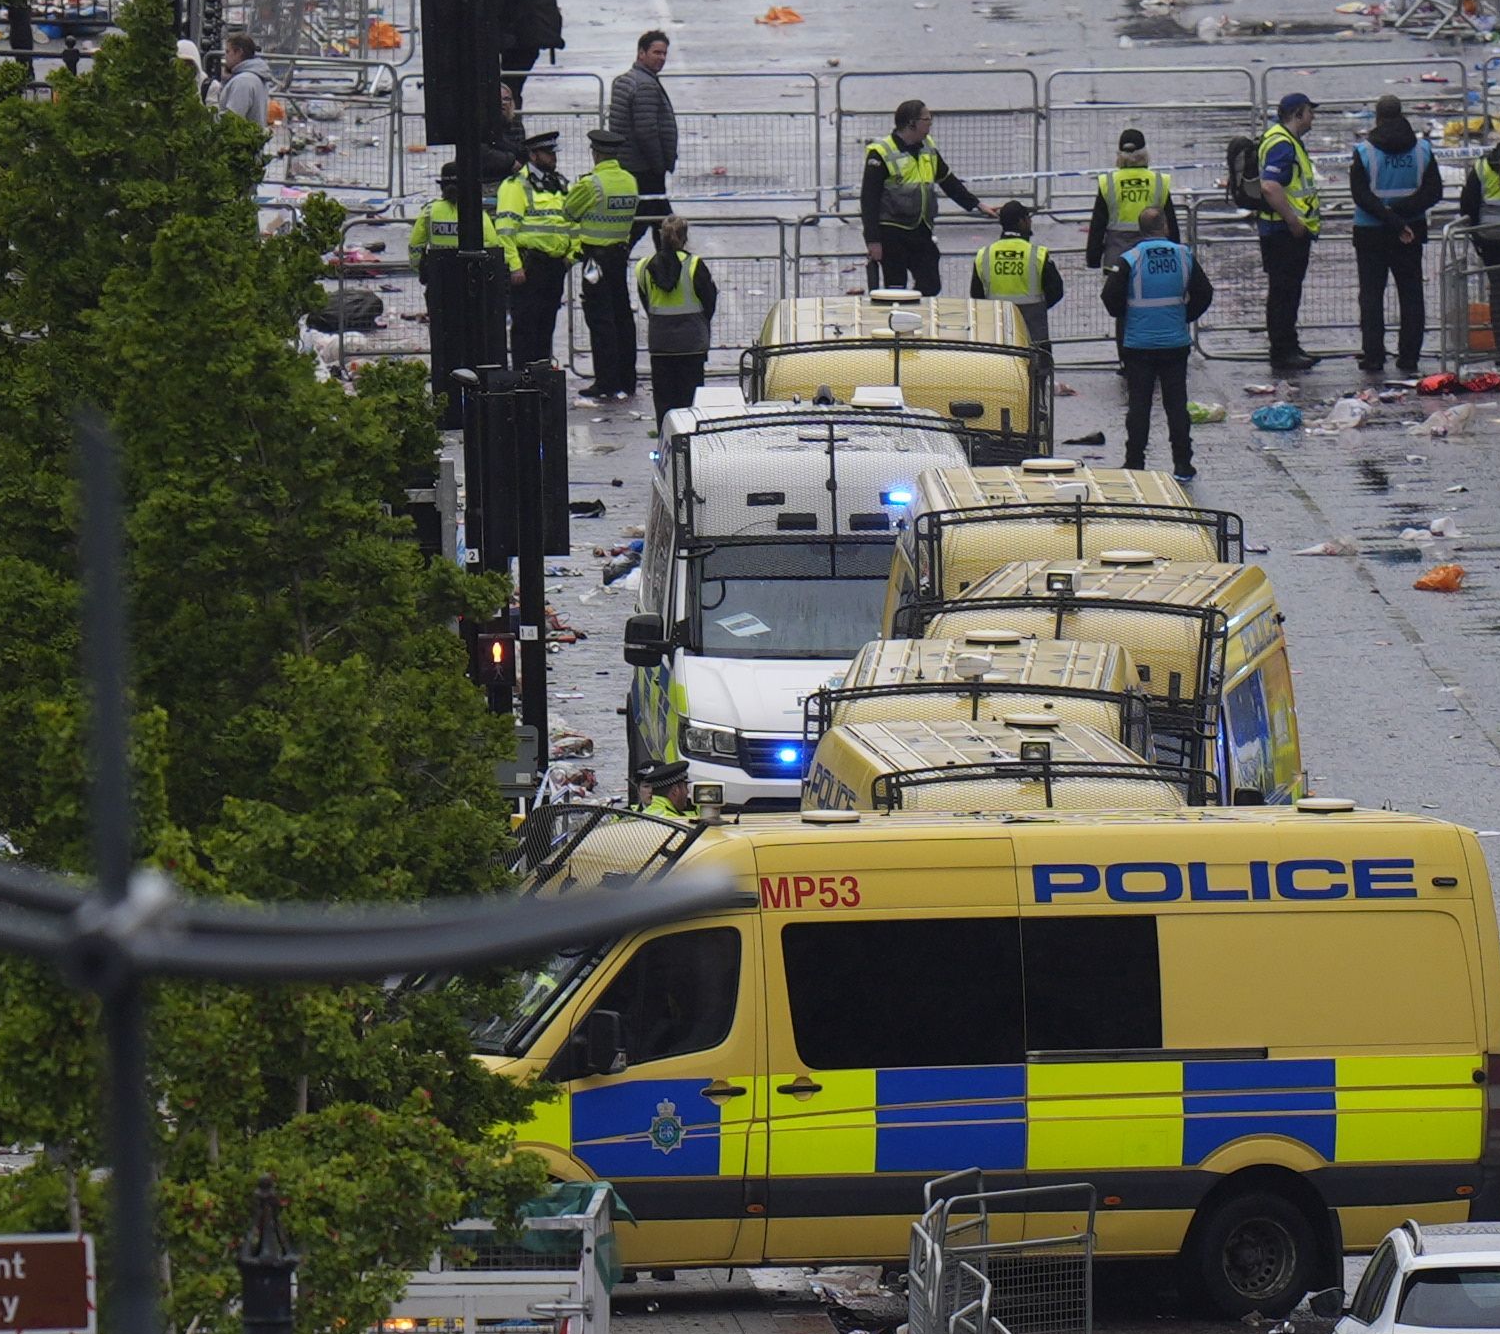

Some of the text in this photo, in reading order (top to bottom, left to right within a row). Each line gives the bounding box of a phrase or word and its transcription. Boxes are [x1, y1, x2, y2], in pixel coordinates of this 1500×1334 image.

[608, 196, 637, 209] POLICE
[1120, 190, 1149, 203] FQ77
[994, 261, 1024, 275] GE28
[1148, 259, 1177, 274] GH90
[469, 551, 476, 561] 2
[1032, 858, 1416, 904] POLICE
[759, 876, 862, 910] MP53
